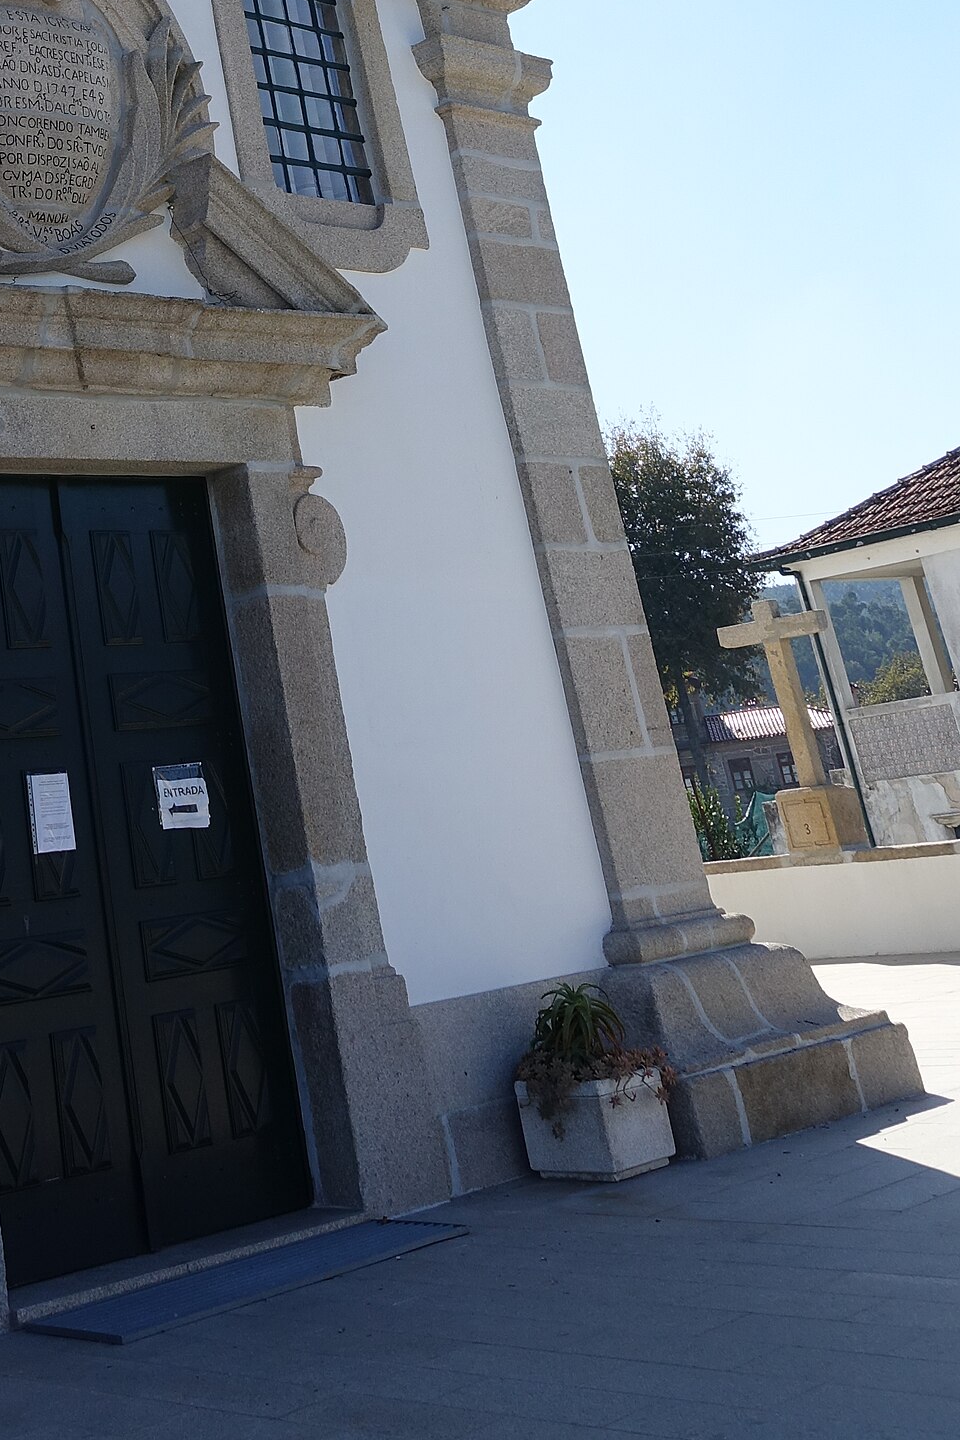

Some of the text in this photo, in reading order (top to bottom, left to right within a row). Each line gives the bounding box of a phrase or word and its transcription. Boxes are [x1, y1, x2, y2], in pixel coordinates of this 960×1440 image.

[6, 10, 41, 24] ESTA
[47, 136, 63, 150] DO
[35, 187, 53, 200] DO
[53, 219, 84, 243] BOAS
[163, 785, 205, 798] ENTRADA
[803, 822, 811, 835] 3
